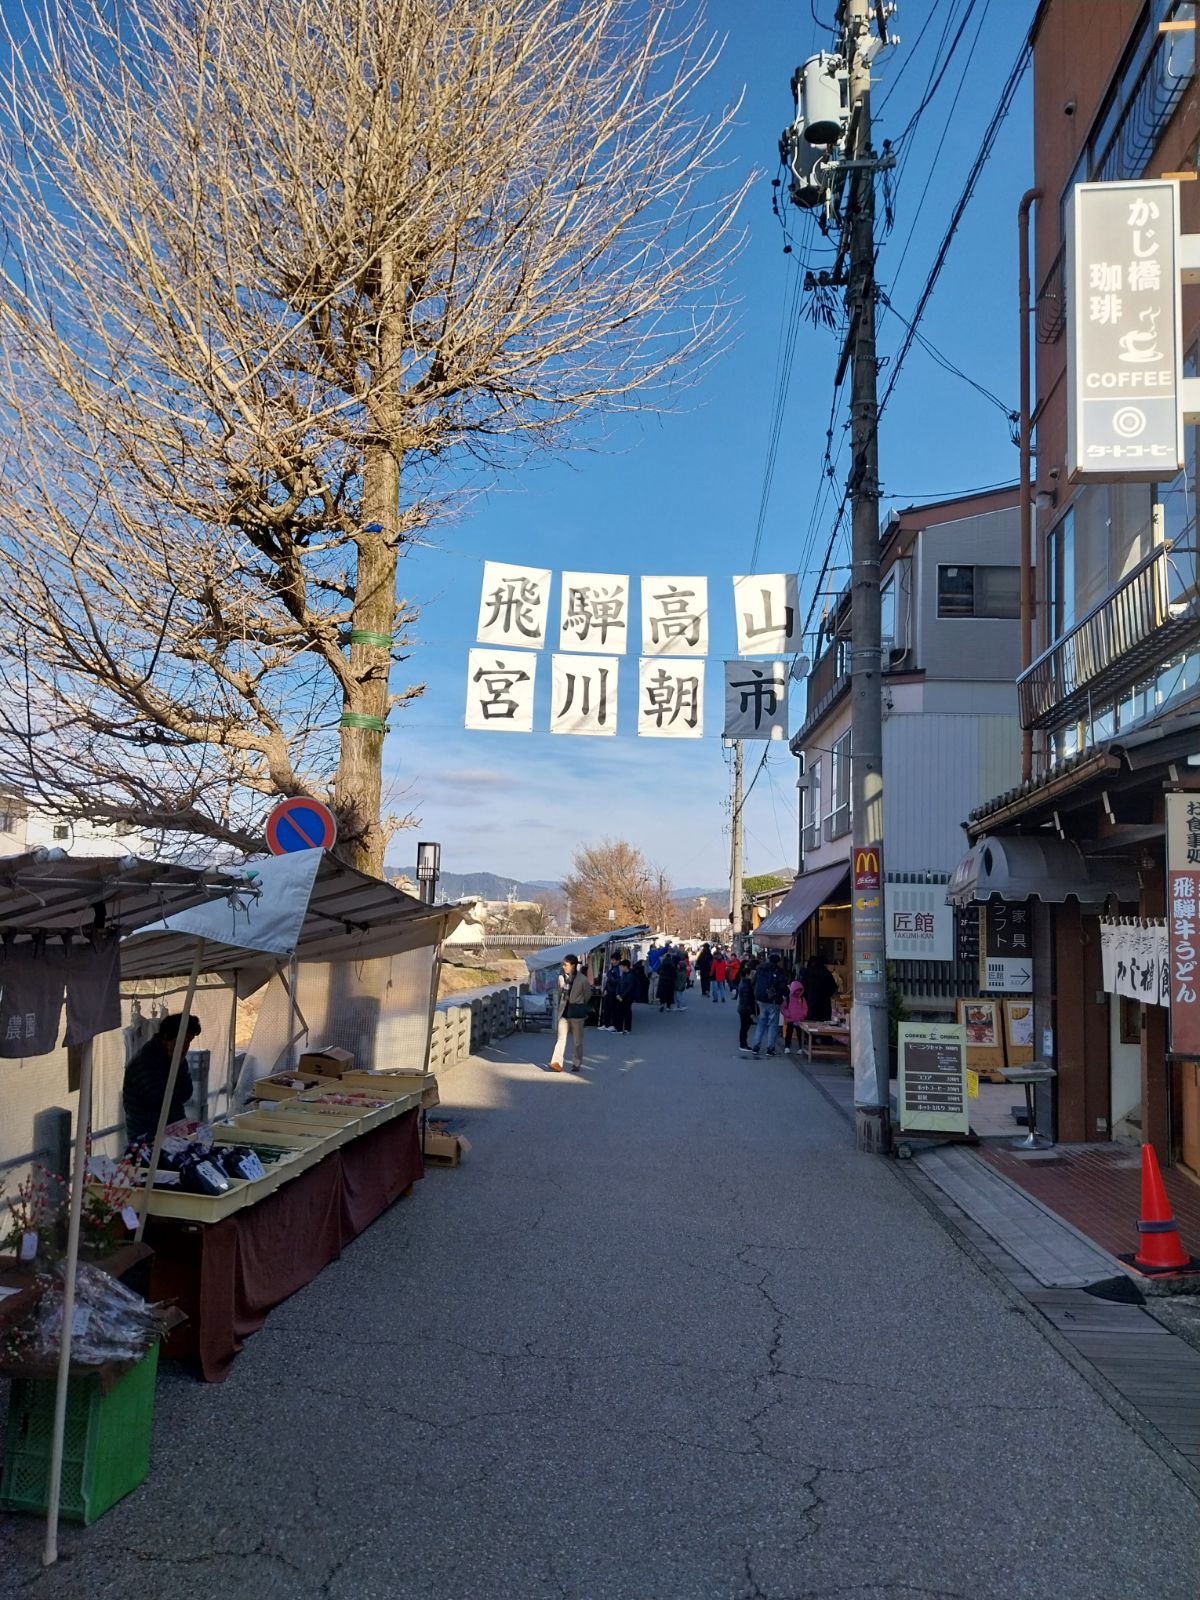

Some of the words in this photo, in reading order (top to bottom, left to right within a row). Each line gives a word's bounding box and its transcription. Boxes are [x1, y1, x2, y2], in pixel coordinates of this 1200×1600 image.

[1127, 198, 1161, 291] かじ橋
[1089, 262, 1122, 325] 珈琲
[1086, 370, 1172, 389] COFFEE
[894, 912, 934, 933] 匠館
[1012, 910, 1027, 948] 家具
[1174, 877, 1198, 1003] 飛騨牛うどん
